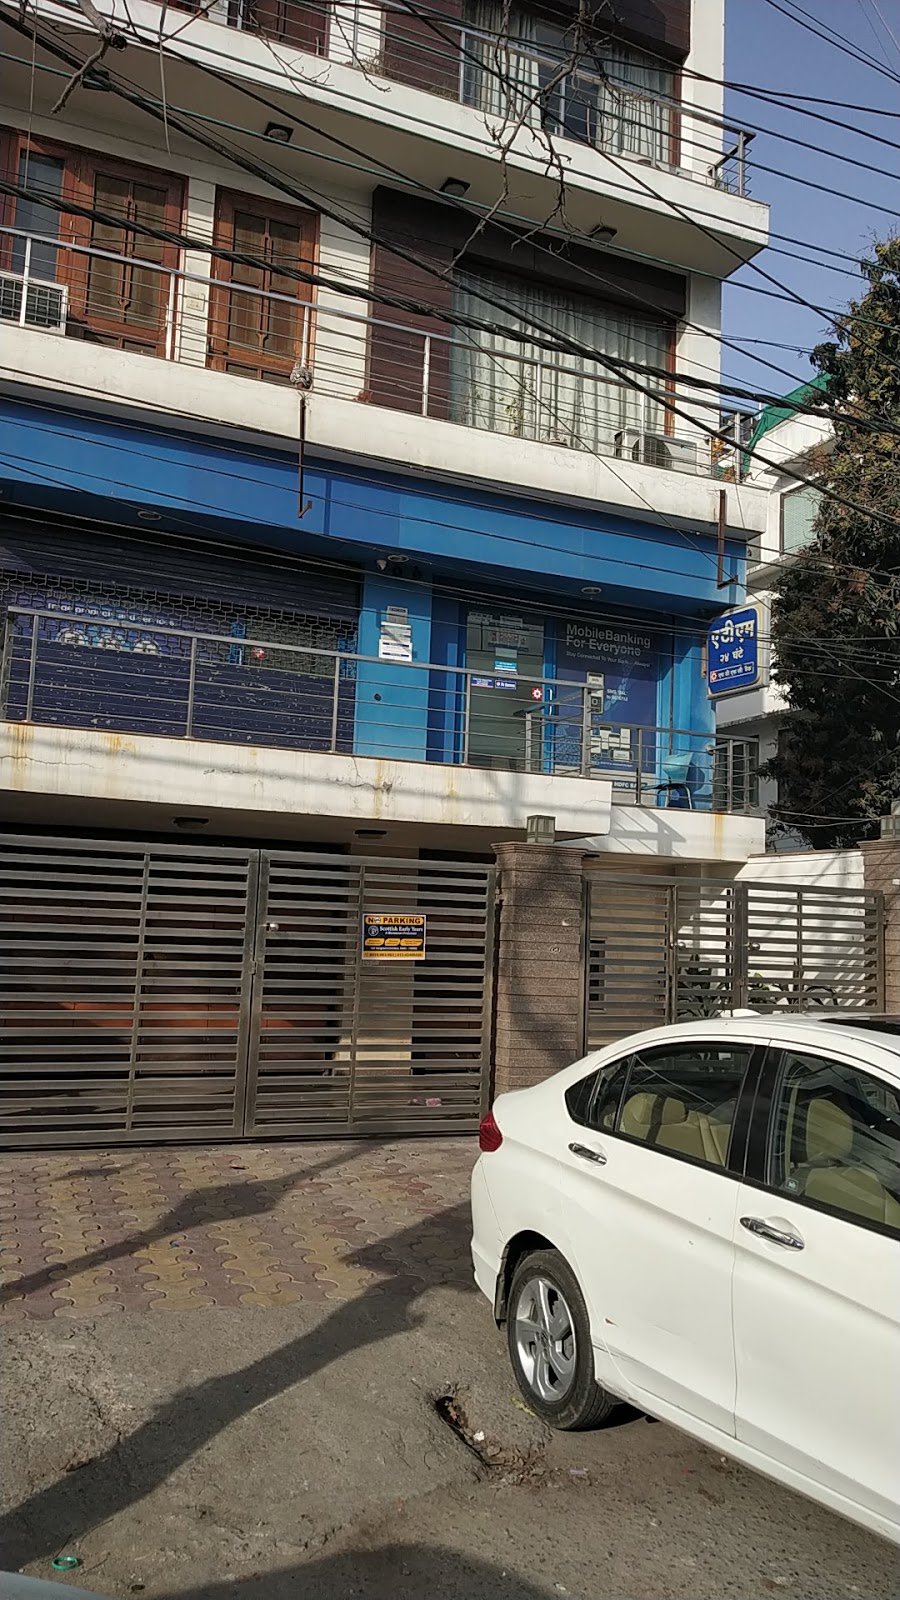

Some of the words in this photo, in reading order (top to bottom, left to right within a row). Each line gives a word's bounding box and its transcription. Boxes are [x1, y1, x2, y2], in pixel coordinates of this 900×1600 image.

[566, 623, 651, 649] MobileBanking
[566, 635, 585, 648] For
[589, 638, 642, 657] Everyone
[711, 619, 755, 650] एटीएम
[577, 652, 601, 661] Connected
